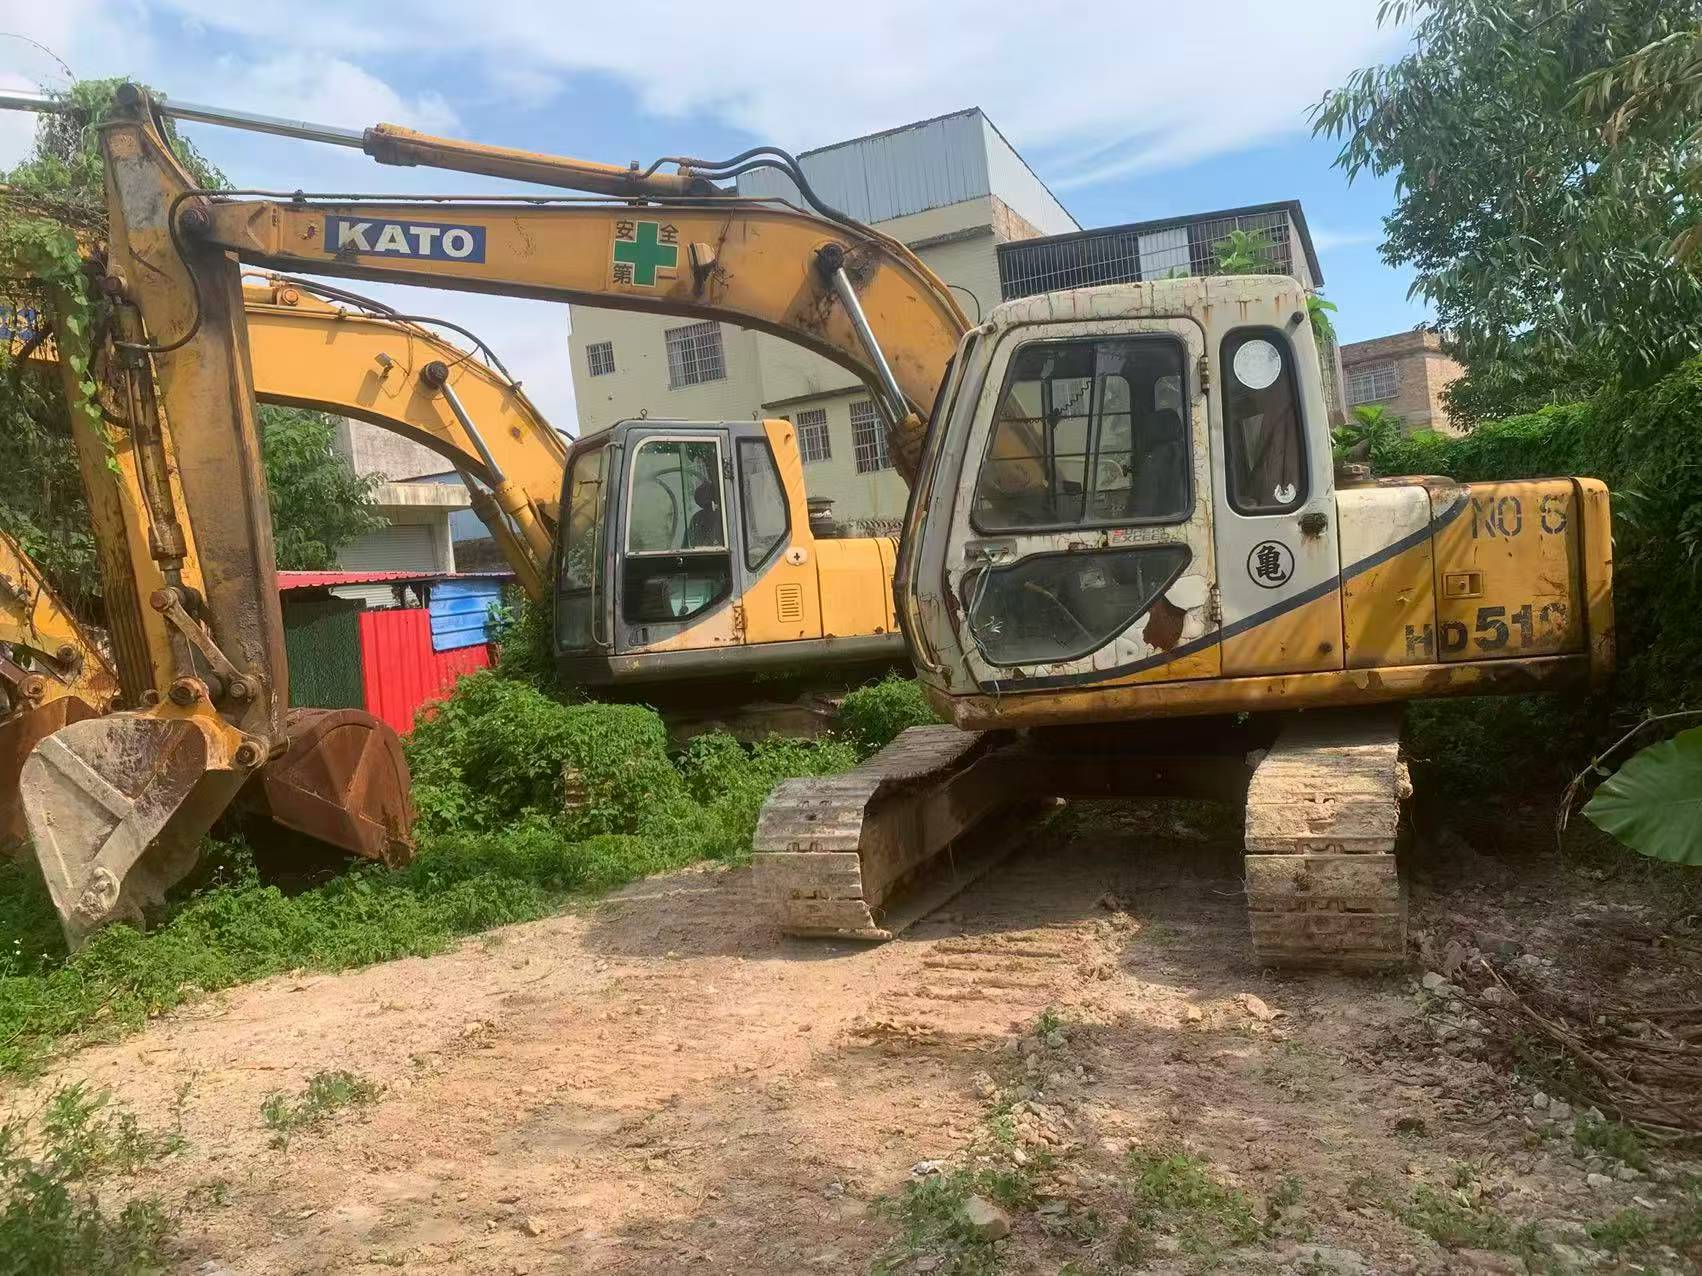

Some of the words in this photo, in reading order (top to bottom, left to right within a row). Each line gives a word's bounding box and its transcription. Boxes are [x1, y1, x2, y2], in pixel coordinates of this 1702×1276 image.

[338, 221, 474, 258] KATO
[615, 219, 679, 244] 安全
[612, 264, 677, 284] 第一
